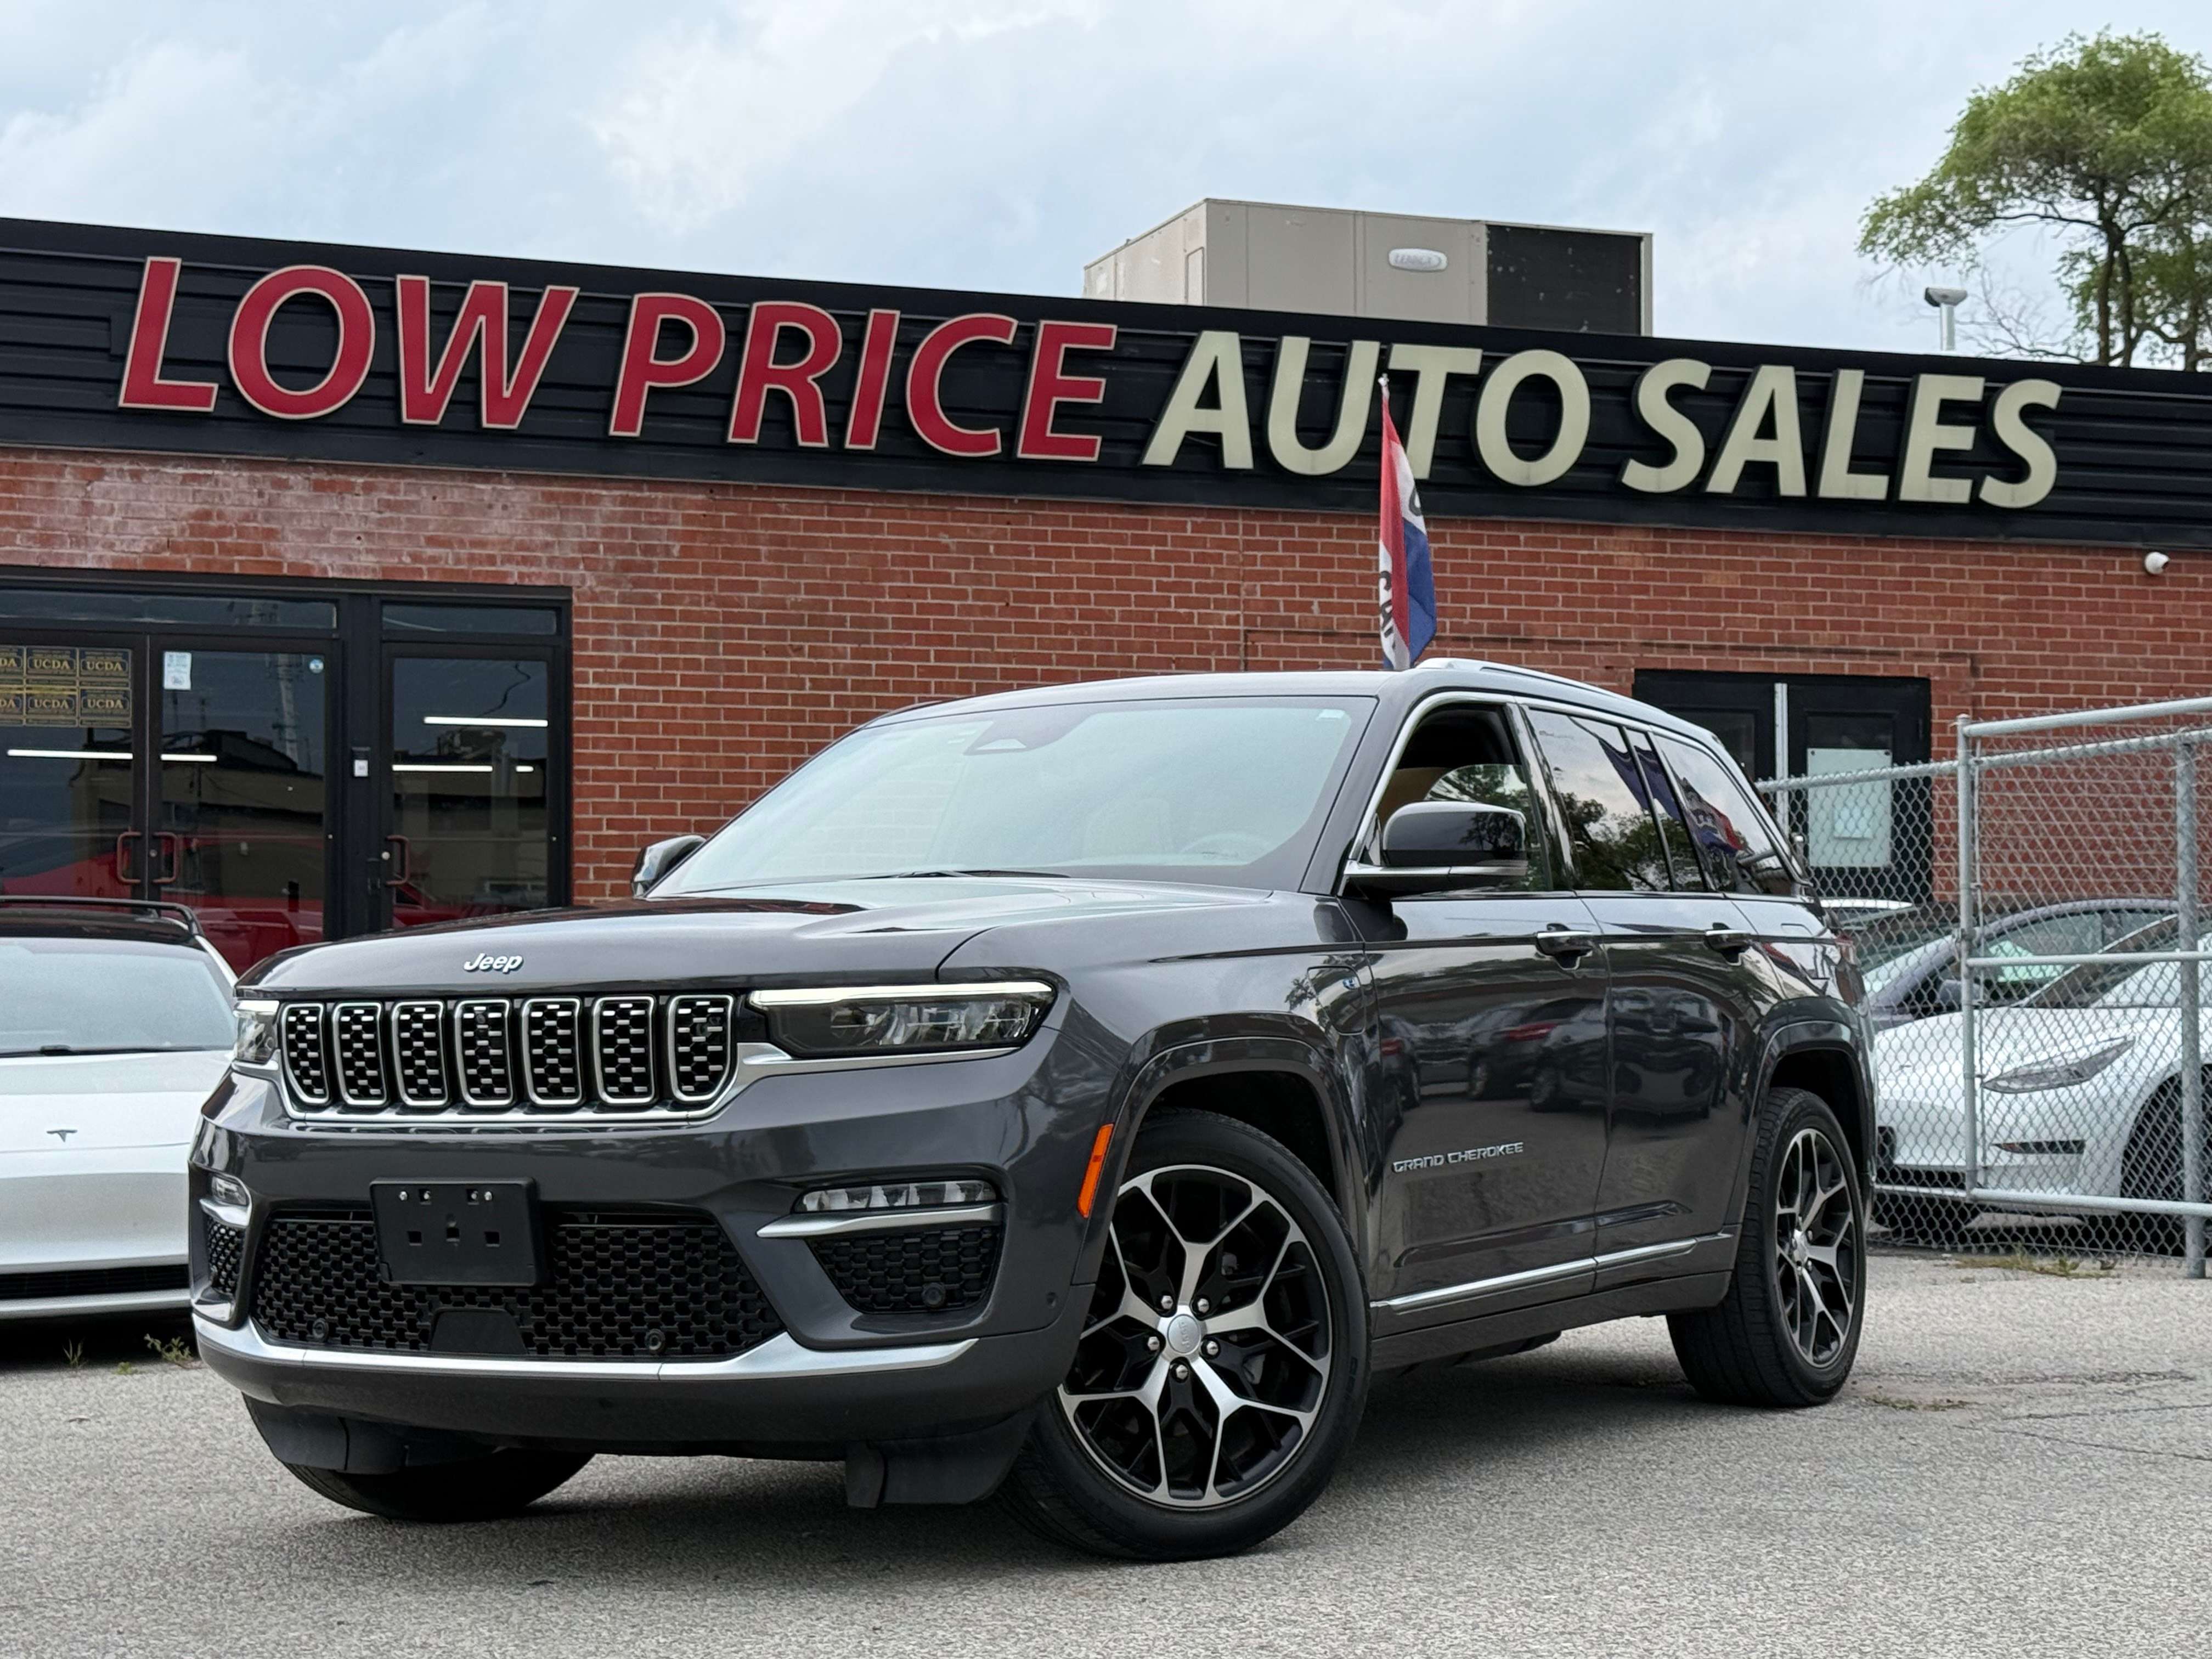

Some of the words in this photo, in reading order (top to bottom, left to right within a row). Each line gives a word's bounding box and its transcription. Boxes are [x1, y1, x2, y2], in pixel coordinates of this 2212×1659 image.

[118, 256, 580, 430] LOW
[608, 292, 1118, 462] PRICE
[1140, 330, 1591, 487] AUTO
[1620, 358, 2063, 509] SALES
[0, 658, 18, 668] DA
[33, 658, 70, 670] UCDA
[86, 661, 123, 671] UCDA
[0, 698, 16, 708] DA
[34, 699, 69, 709] UCDA
[87, 699, 123, 709] UCDA
[464, 952, 524, 974] Jeep
[1392, 1154, 1444, 1173] GRAND
[1447, 1142, 1524, 1164] CHEROKEE
